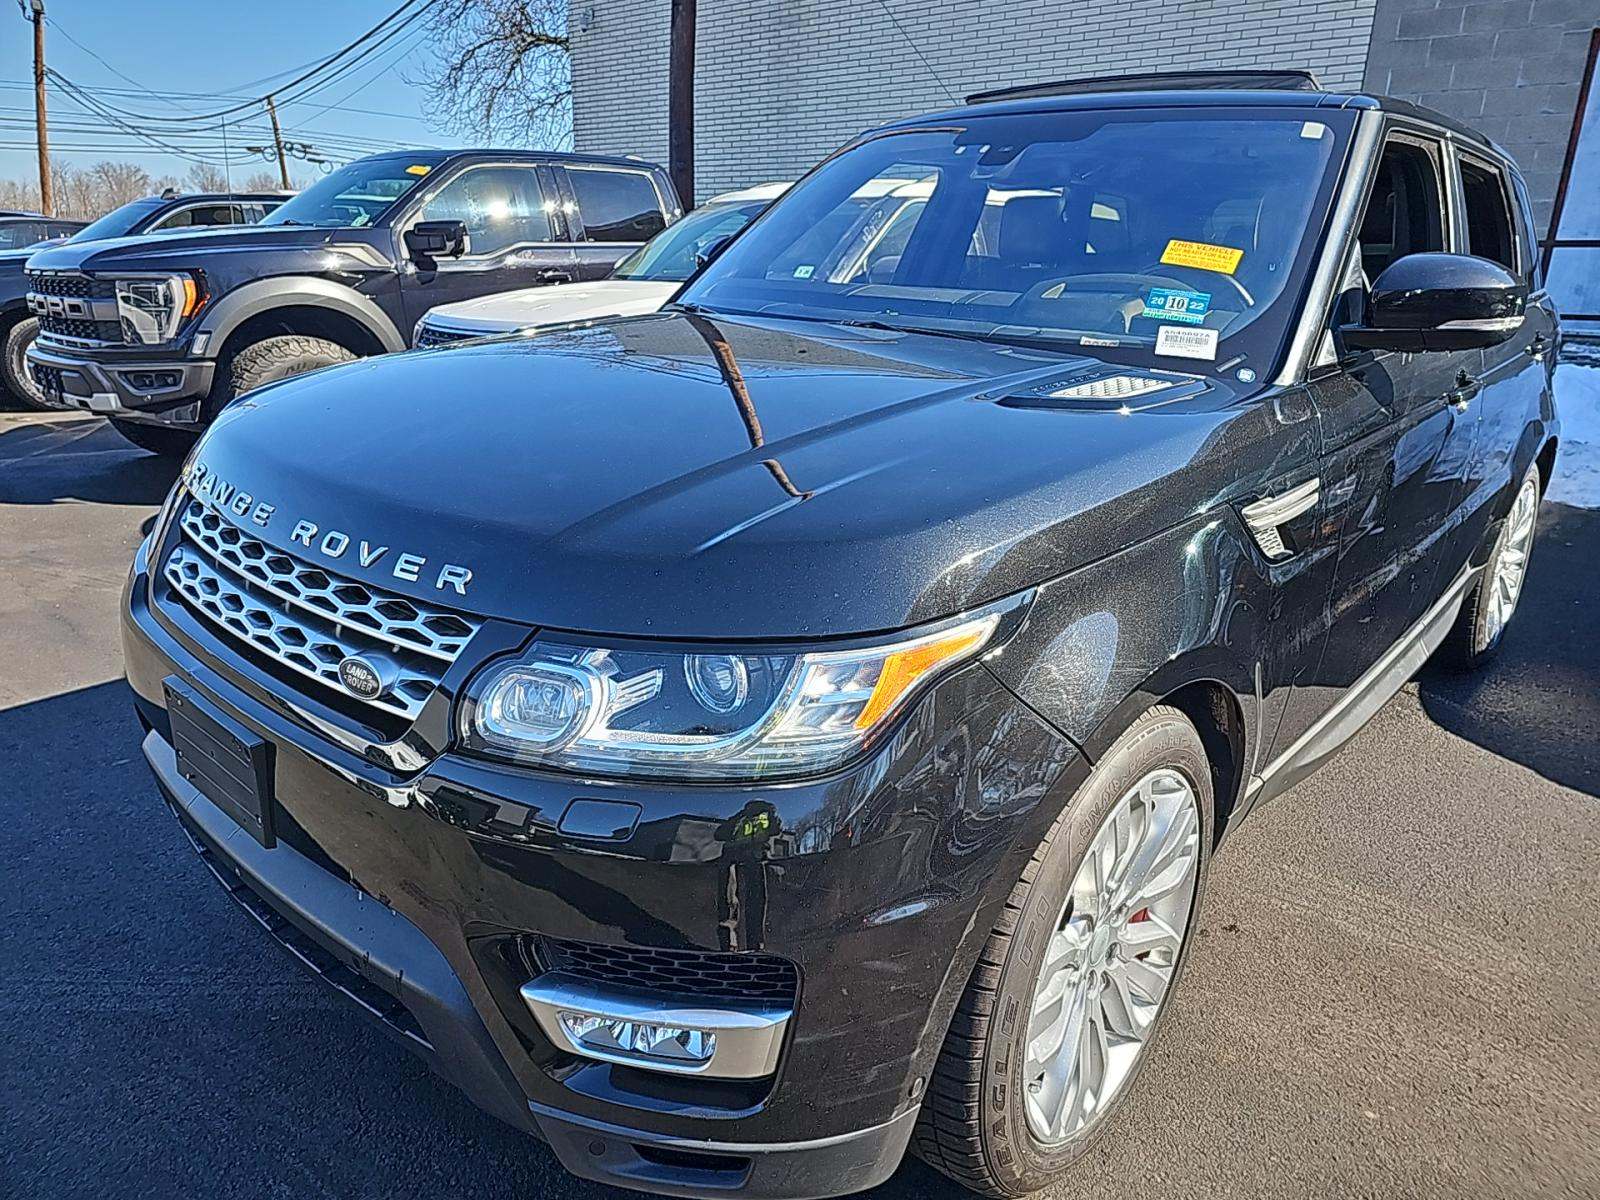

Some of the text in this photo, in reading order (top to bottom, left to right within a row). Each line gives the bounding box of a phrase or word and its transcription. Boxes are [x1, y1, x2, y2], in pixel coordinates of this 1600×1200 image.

[1173, 241, 1235, 255] THIS VEHICLE
[26, 292, 86, 319] FORD
[1150, 297, 1205, 310] 20 10 22
[189, 462, 474, 595] RANGE ROVER
[346, 663, 368, 680] LAND
[346, 674, 373, 693] ROVER
[992, 995, 1020, 1167] EAGLE
